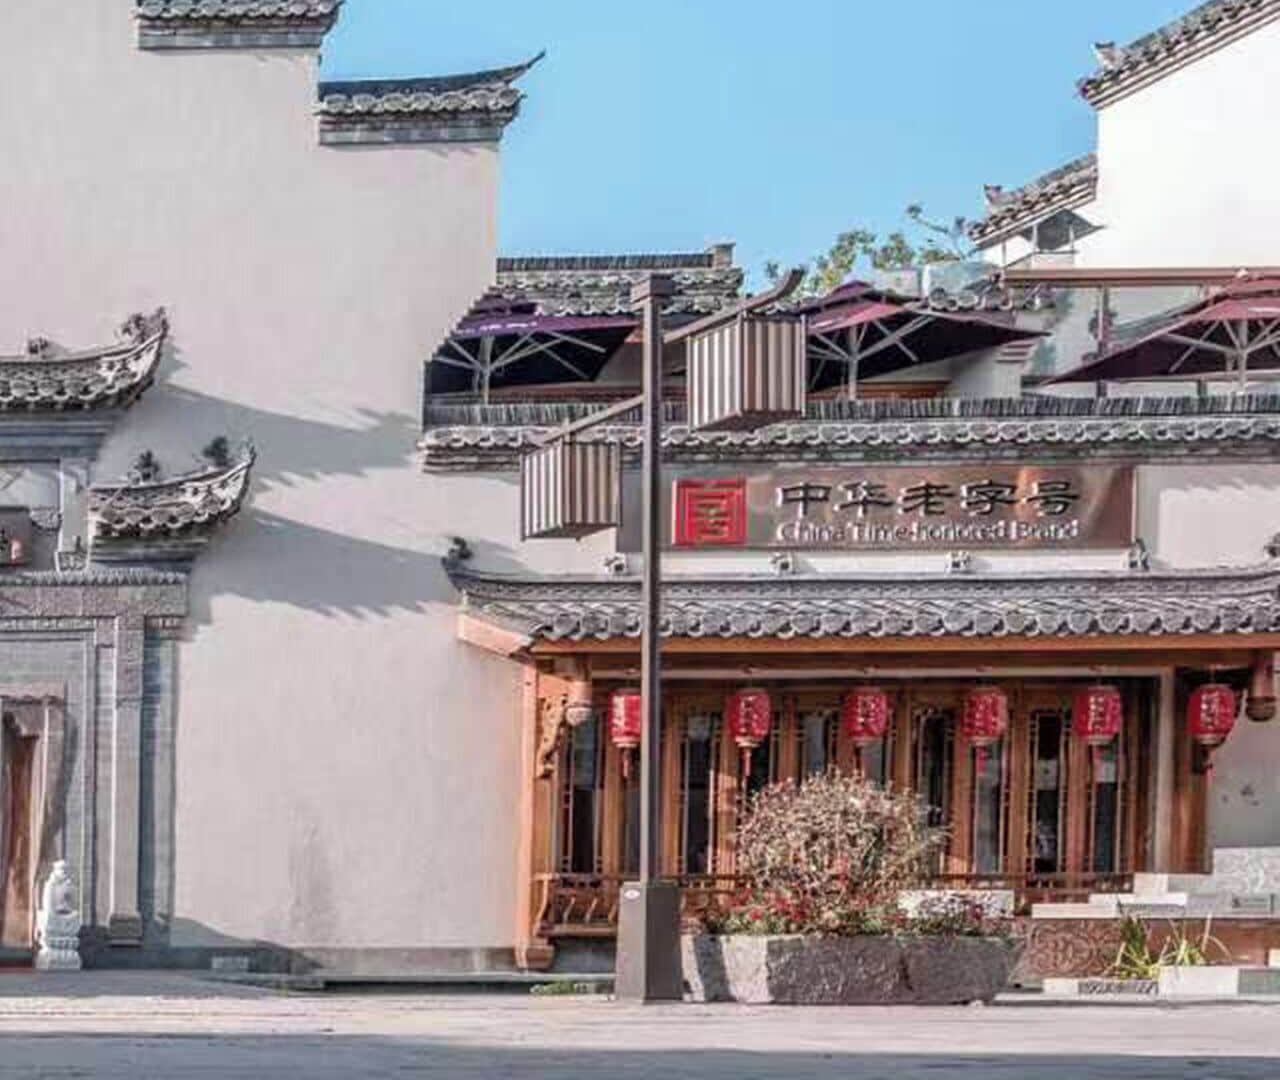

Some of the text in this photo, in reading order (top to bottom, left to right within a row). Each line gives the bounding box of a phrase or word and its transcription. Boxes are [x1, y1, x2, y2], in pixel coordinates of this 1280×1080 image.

[774, 478, 1081, 519] 中华老字号
[775, 520, 1081, 543] China Time-honored Brand
